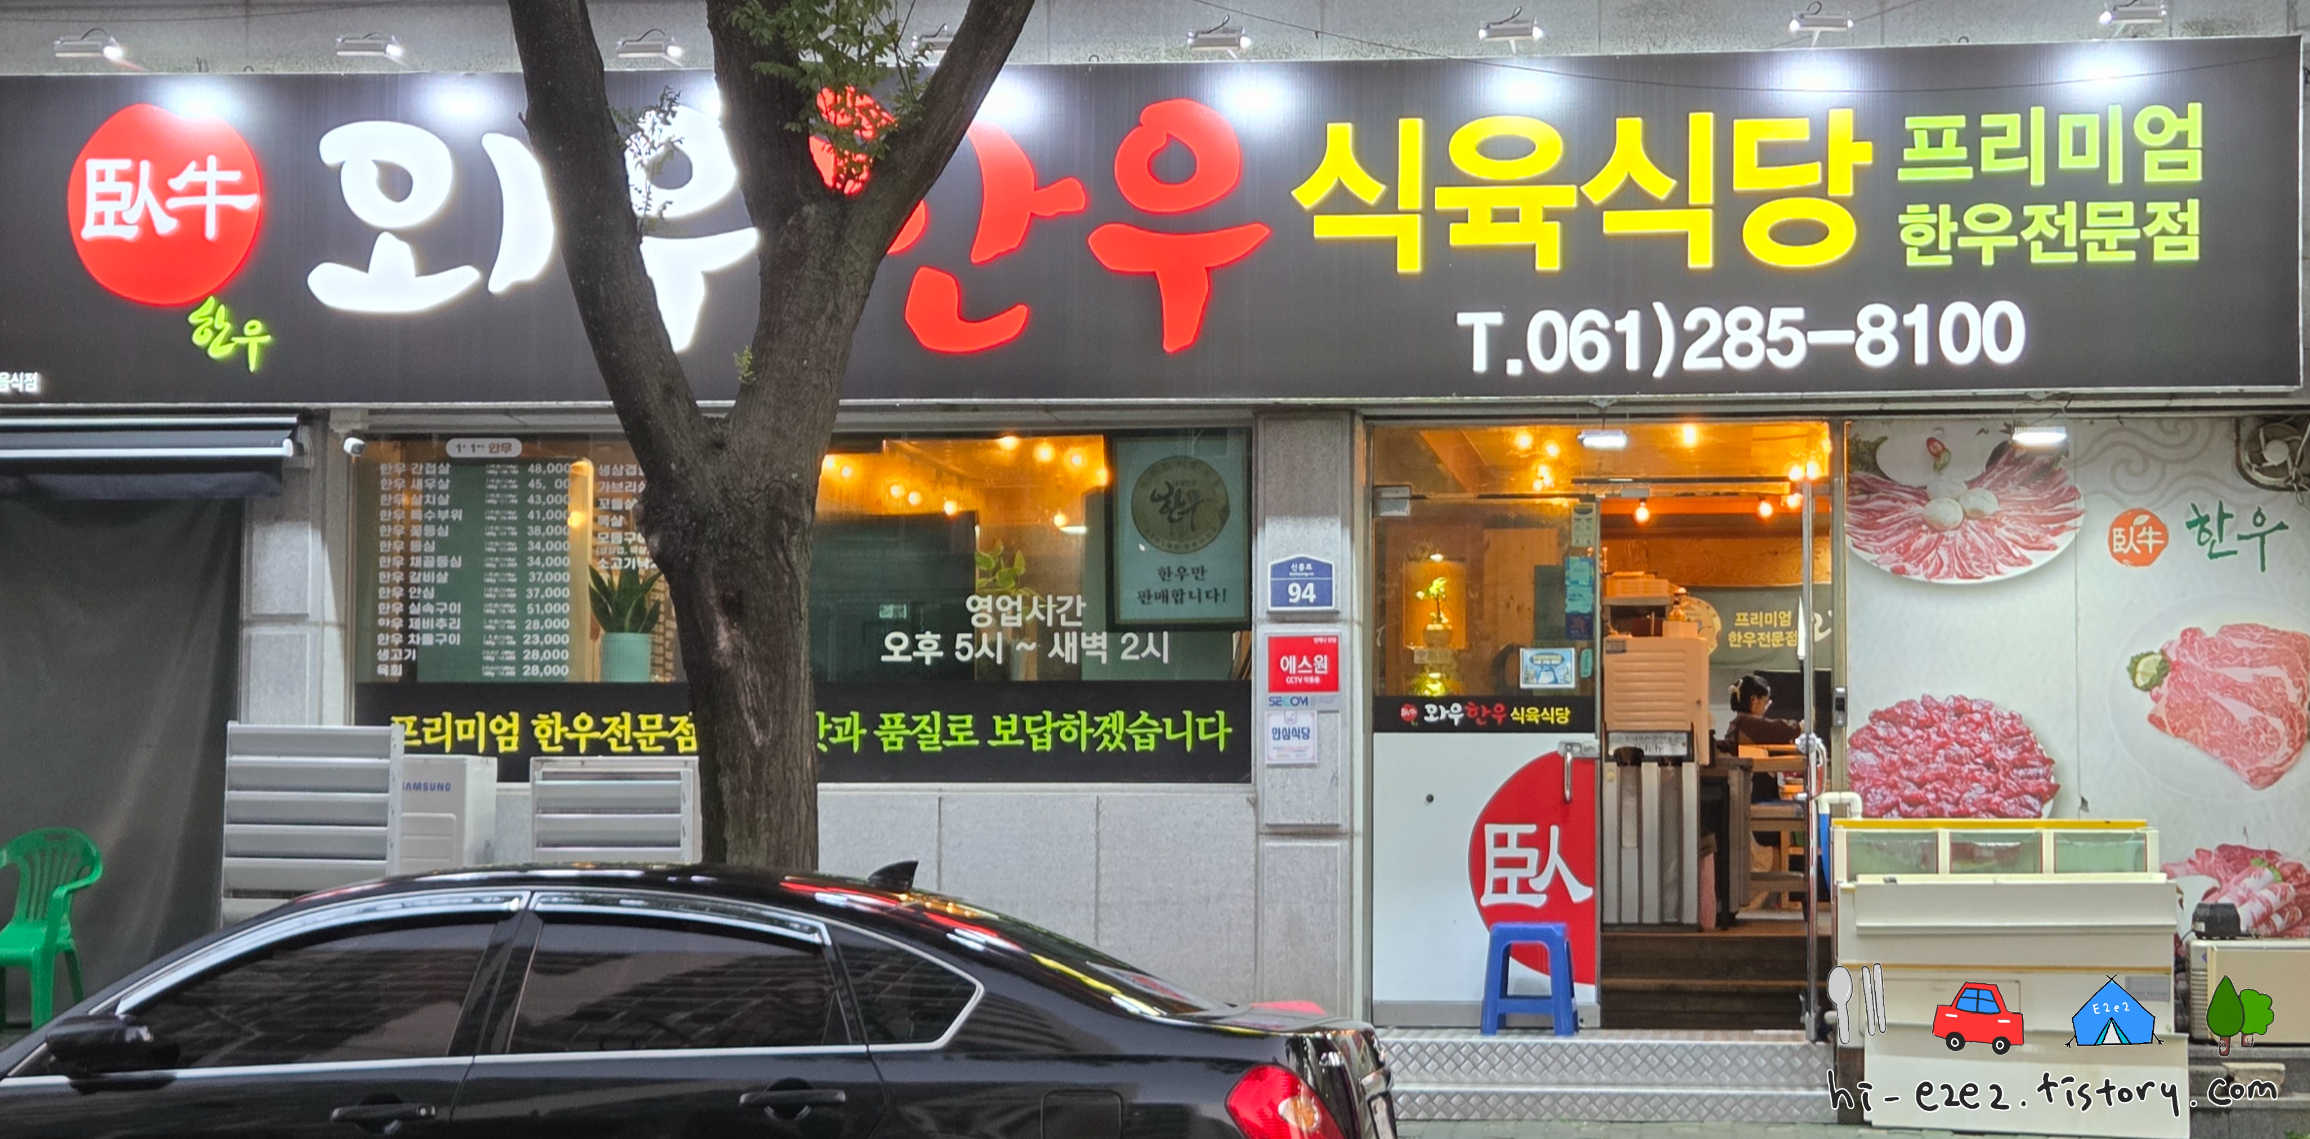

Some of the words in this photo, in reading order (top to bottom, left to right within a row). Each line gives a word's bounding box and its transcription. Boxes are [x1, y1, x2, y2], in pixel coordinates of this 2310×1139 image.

[1897, 102, 2203, 186] 프리미엄
[81, 154, 259, 241] 臥牛
[1290, 108, 1873, 274] 식육식당
[1897, 198, 2203, 267] 한우전문점
[188, 295, 271, 373] 한우
[380, 463, 406, 475] 한우
[380, 478, 406, 490] 한우
[410, 478, 450, 490] 새우살
[380, 494, 405, 506] 한우
[527, 494, 570, 507] 43,000
[379, 509, 405, 521] 한우
[379, 524, 405, 537] 한우
[527, 525, 570, 538] 38,000
[2185, 500, 2290, 573] 한우
[379, 540, 404, 553] 한우
[527, 540, 570, 553] 34,000
[379, 555, 404, 568] 한우
[527, 556, 570, 568] 34,000
[378, 571, 404, 584] 한우
[409, 571, 449, 584] 갈비살
[528, 571, 570, 584] 37,000
[1157, 565, 1208, 582] 한우만
[378, 587, 404, 599] 한우
[408, 587, 435, 599] 안심
[526, 587, 570, 599] 37,000
[1137, 588, 1227, 605] 판매합니다!
[1288, 582, 1316, 604] 94
[378, 602, 404, 615] 한우
[408, 602, 461, 615] 실속구이
[527, 602, 570, 615] 51,000
[965, 594, 1087, 629] 영업시간
[408, 618, 461, 630] 제비추리
[524, 618, 570, 631] 28,000
[1734, 610, 1792, 628] 프리미엄
[377, 633, 403, 646] 한우
[523, 633, 570, 646] 23,000
[1727, 630, 1798, 649] 한우전문점
[376, 648, 417, 662] 생고기
[523, 649, 569, 662] 28,000
[880, 630, 944, 666] 오후
[954, 631, 1004, 666] 5시
[1047, 630, 1109, 665] 새벽
[1120, 630, 1170, 665] 2시
[522, 664, 569, 677] 28,000
[1279, 654, 1328, 675] 에스원
[1285, 675, 1303, 684] CCTV
[1268, 696, 1309, 707] SECOM
[1510, 706, 1570, 724] 식육식당
[390, 711, 520, 754] 프리미엄
[531, 711, 698, 754] 한우전문점
[873, 711, 980, 754] 품질로
[987, 710, 1232, 754] 보답하겠습니다
[1271, 726, 1311, 741] 안심식당
[402, 782, 452, 792] AMSUNG
